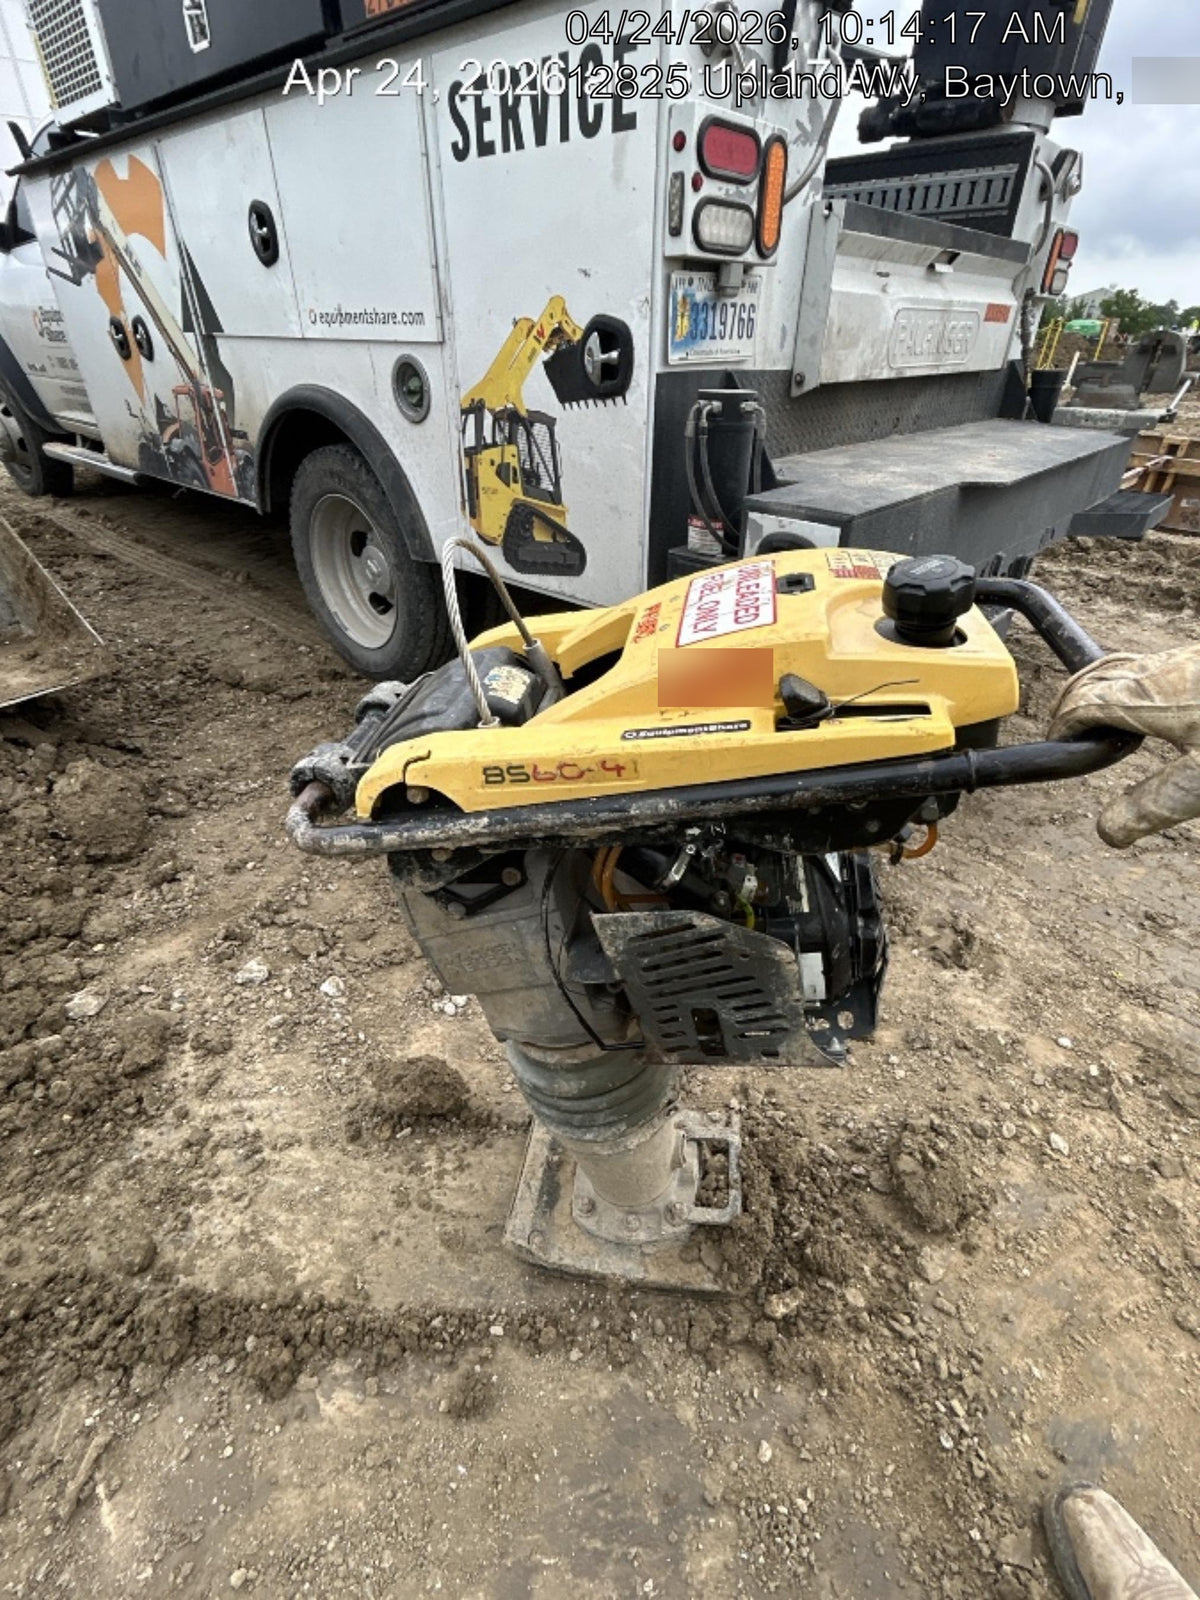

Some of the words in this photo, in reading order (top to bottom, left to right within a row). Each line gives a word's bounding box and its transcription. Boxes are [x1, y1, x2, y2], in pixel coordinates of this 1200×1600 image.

[447, 33, 637, 163] SERVICE
[319, 305, 426, 327] equipmentshare.com
[690, 302, 757, 341] 3319766
[698, 573, 725, 602] FUEL
[733, 564, 760, 625] UNLEADED
[692, 600, 720, 634] ONLY
